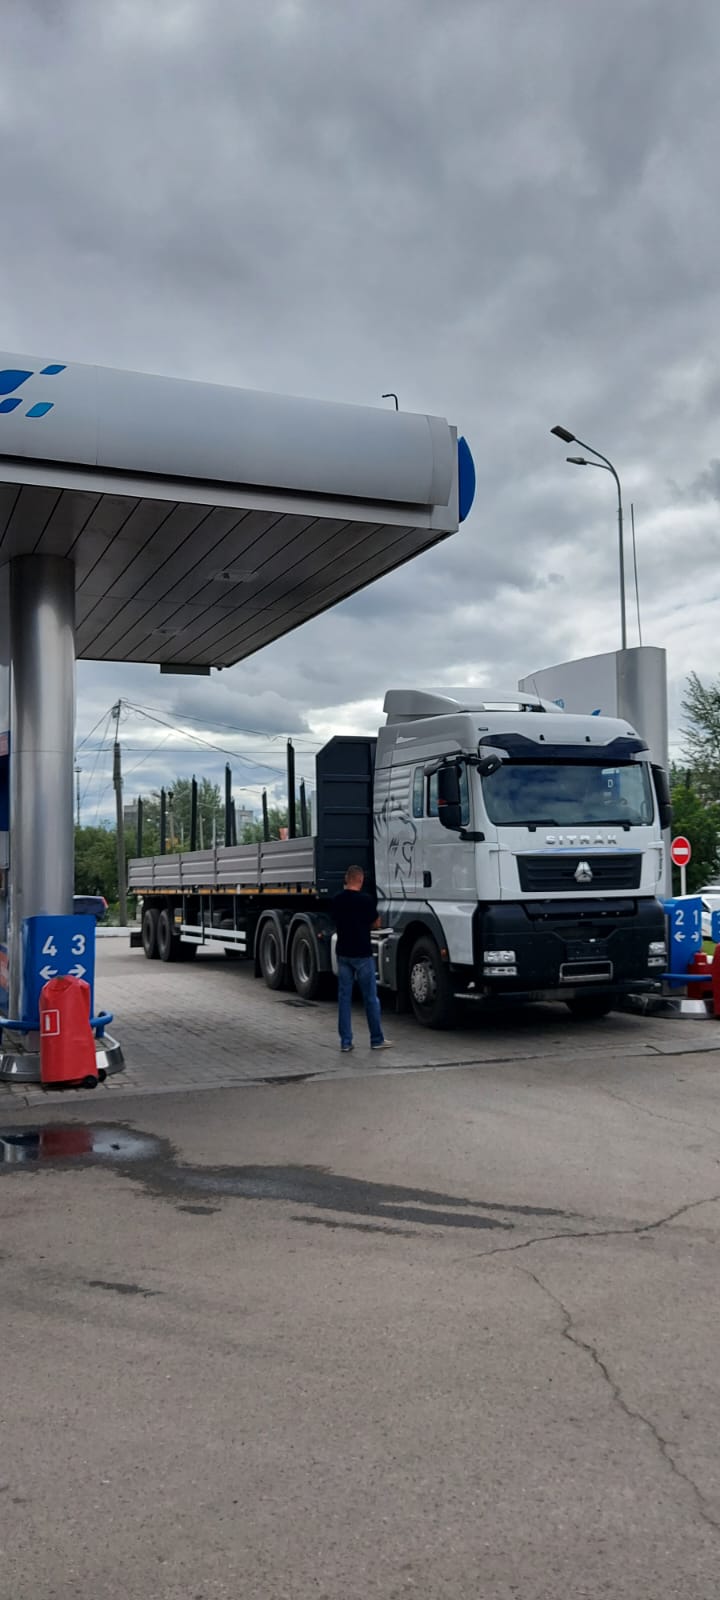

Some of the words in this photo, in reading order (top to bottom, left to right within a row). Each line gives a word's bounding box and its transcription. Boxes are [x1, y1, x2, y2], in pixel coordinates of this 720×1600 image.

[545, 834, 617, 845] SITRAK
[675, 909, 685, 926] 2
[692, 909, 699, 926] 1
[42, 935, 58, 957] 4
[71, 934, 86, 956] 3
